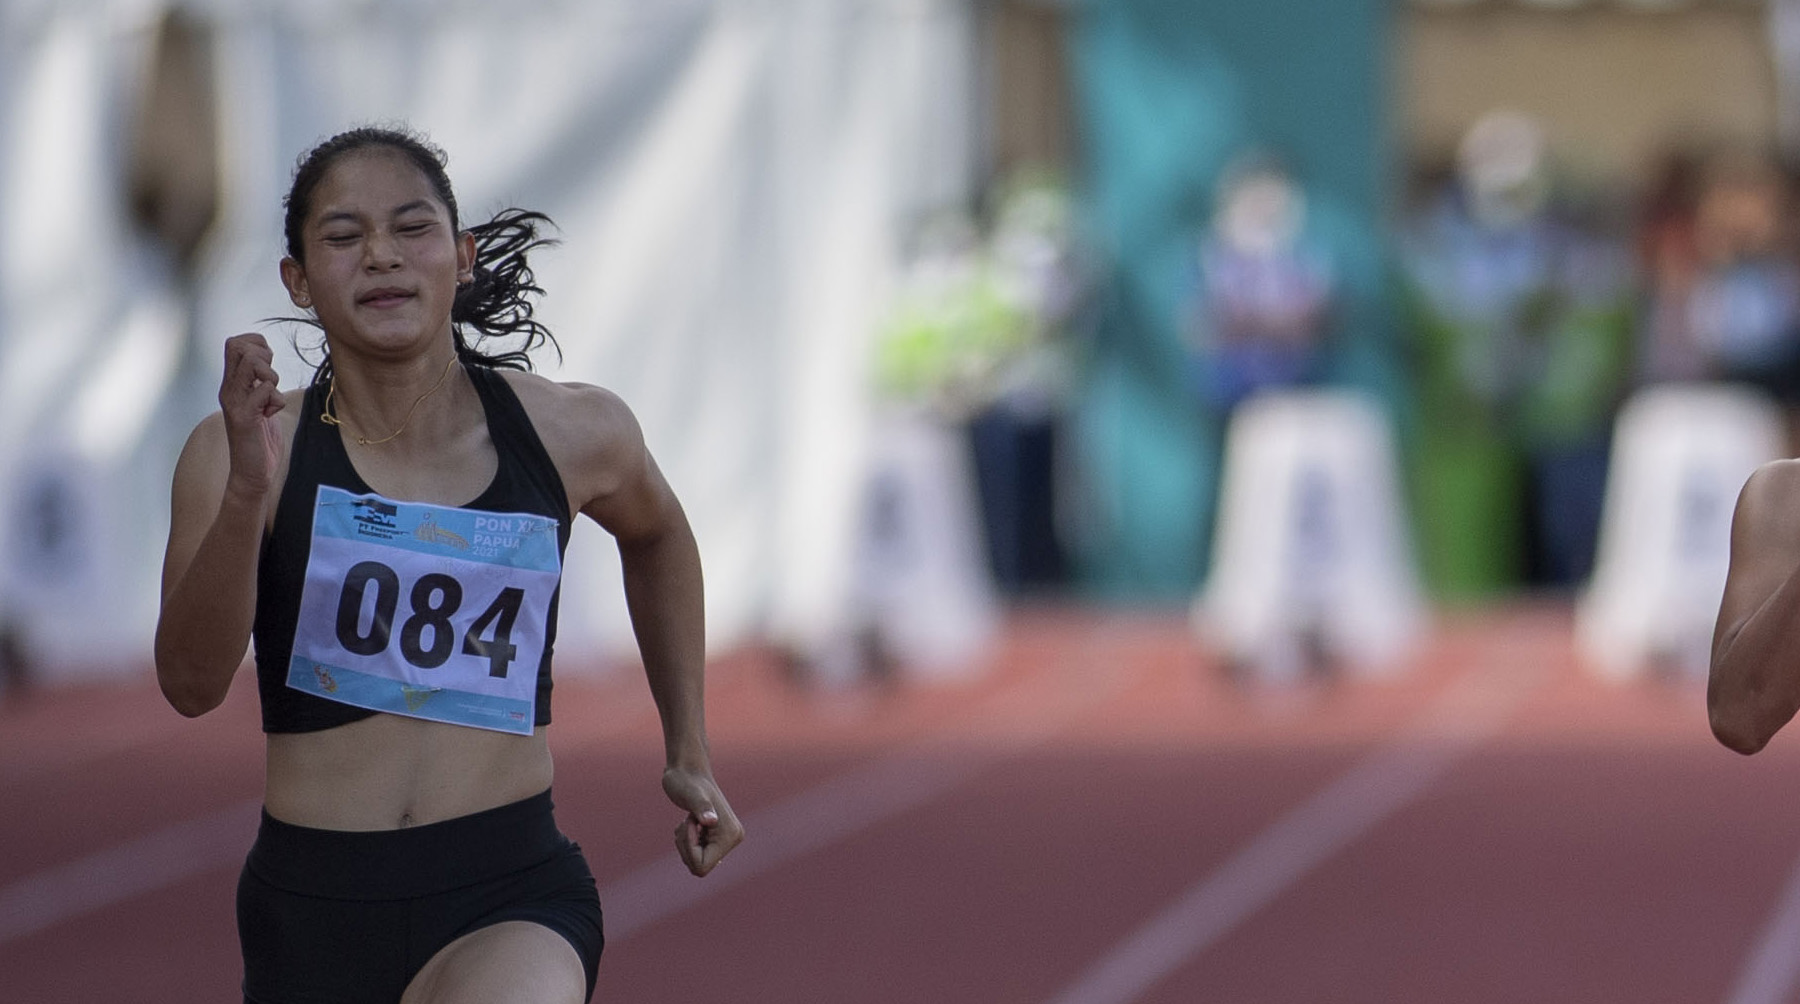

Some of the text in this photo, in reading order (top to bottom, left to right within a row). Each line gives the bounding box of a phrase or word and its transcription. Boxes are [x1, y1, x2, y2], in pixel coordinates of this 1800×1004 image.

[475, 517, 512, 532] PON
[473, 533, 520, 549] PAPUA
[472, 546, 498, 557] 2021
[335, 560, 525, 679] 084
